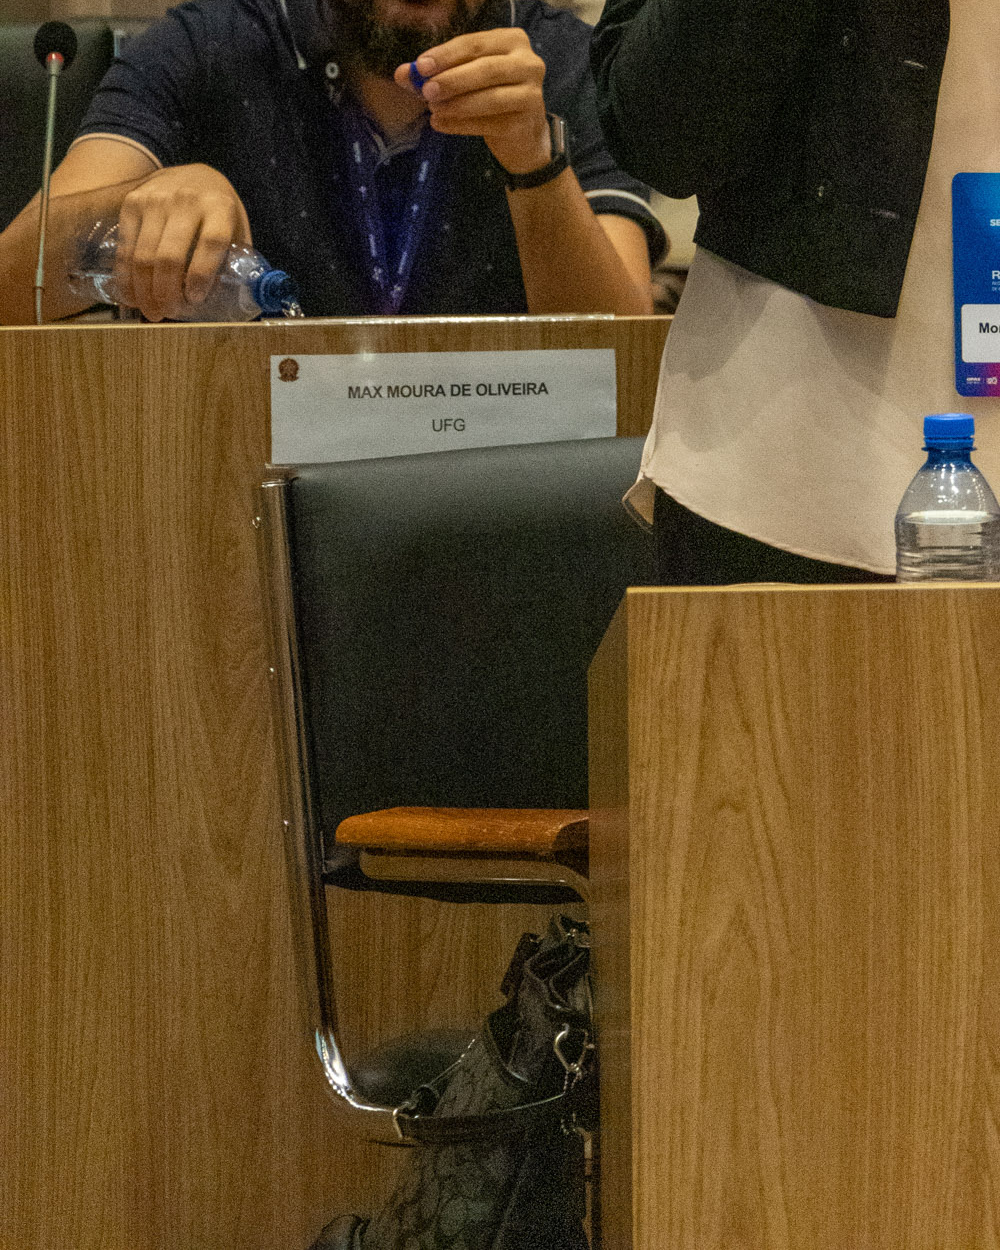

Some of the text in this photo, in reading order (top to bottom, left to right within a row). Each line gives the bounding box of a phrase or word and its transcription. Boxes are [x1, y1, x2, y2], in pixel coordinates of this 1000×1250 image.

[347, 382, 549, 399] MAX MOURA DE OLIVEIRA
[432, 418, 466, 432] UFG
